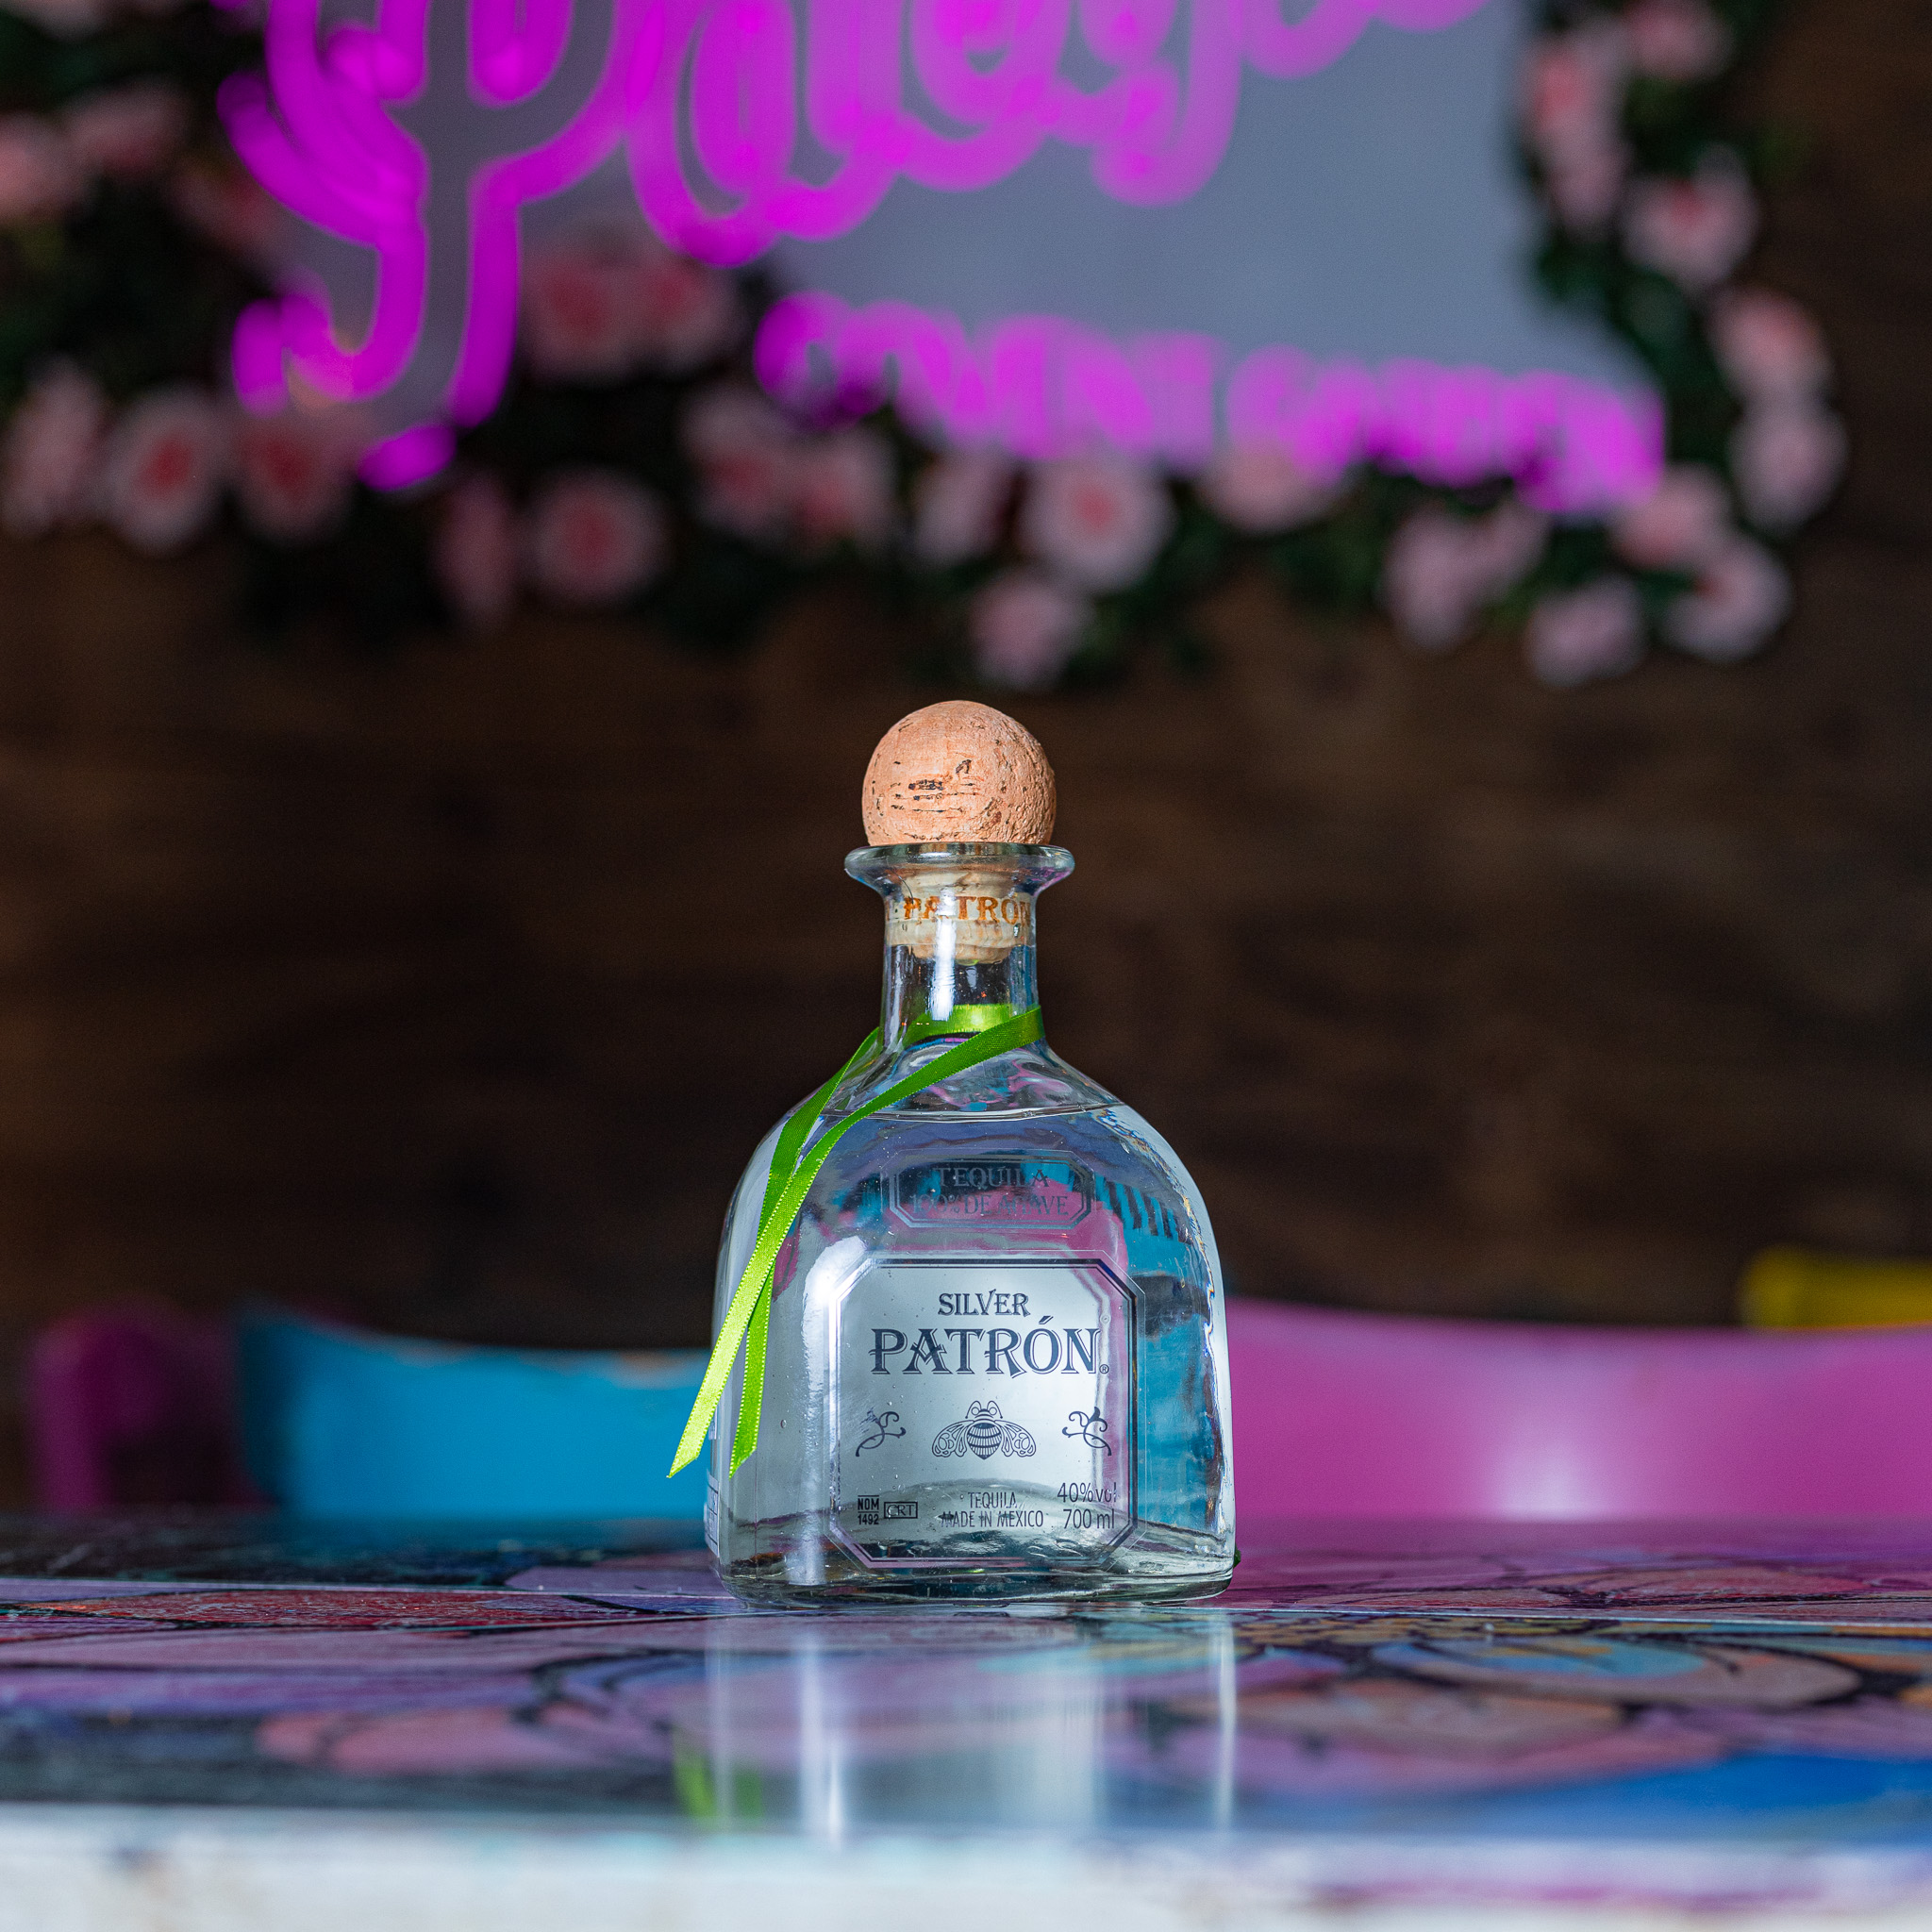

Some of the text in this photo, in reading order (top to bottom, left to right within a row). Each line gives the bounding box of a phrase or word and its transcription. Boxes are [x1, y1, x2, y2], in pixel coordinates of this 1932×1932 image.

[939, 1167, 1049, 1191] TEQUILA
[964, 1193, 990, 1214] DE
[938, 1289, 1031, 1317] SILVER
[968, 1491, 1018, 1510] TEQUILA
[1057, 1483, 1093, 1504] 40%
[858, 1498, 879, 1510] NOM
[887, 1504, 914, 1517] CRT
[858, 1513, 879, 1525] 1492
[941, 1509, 1043, 1528] MADE IN MEXICO
[1063, 1508, 1115, 1528] 700 ml
